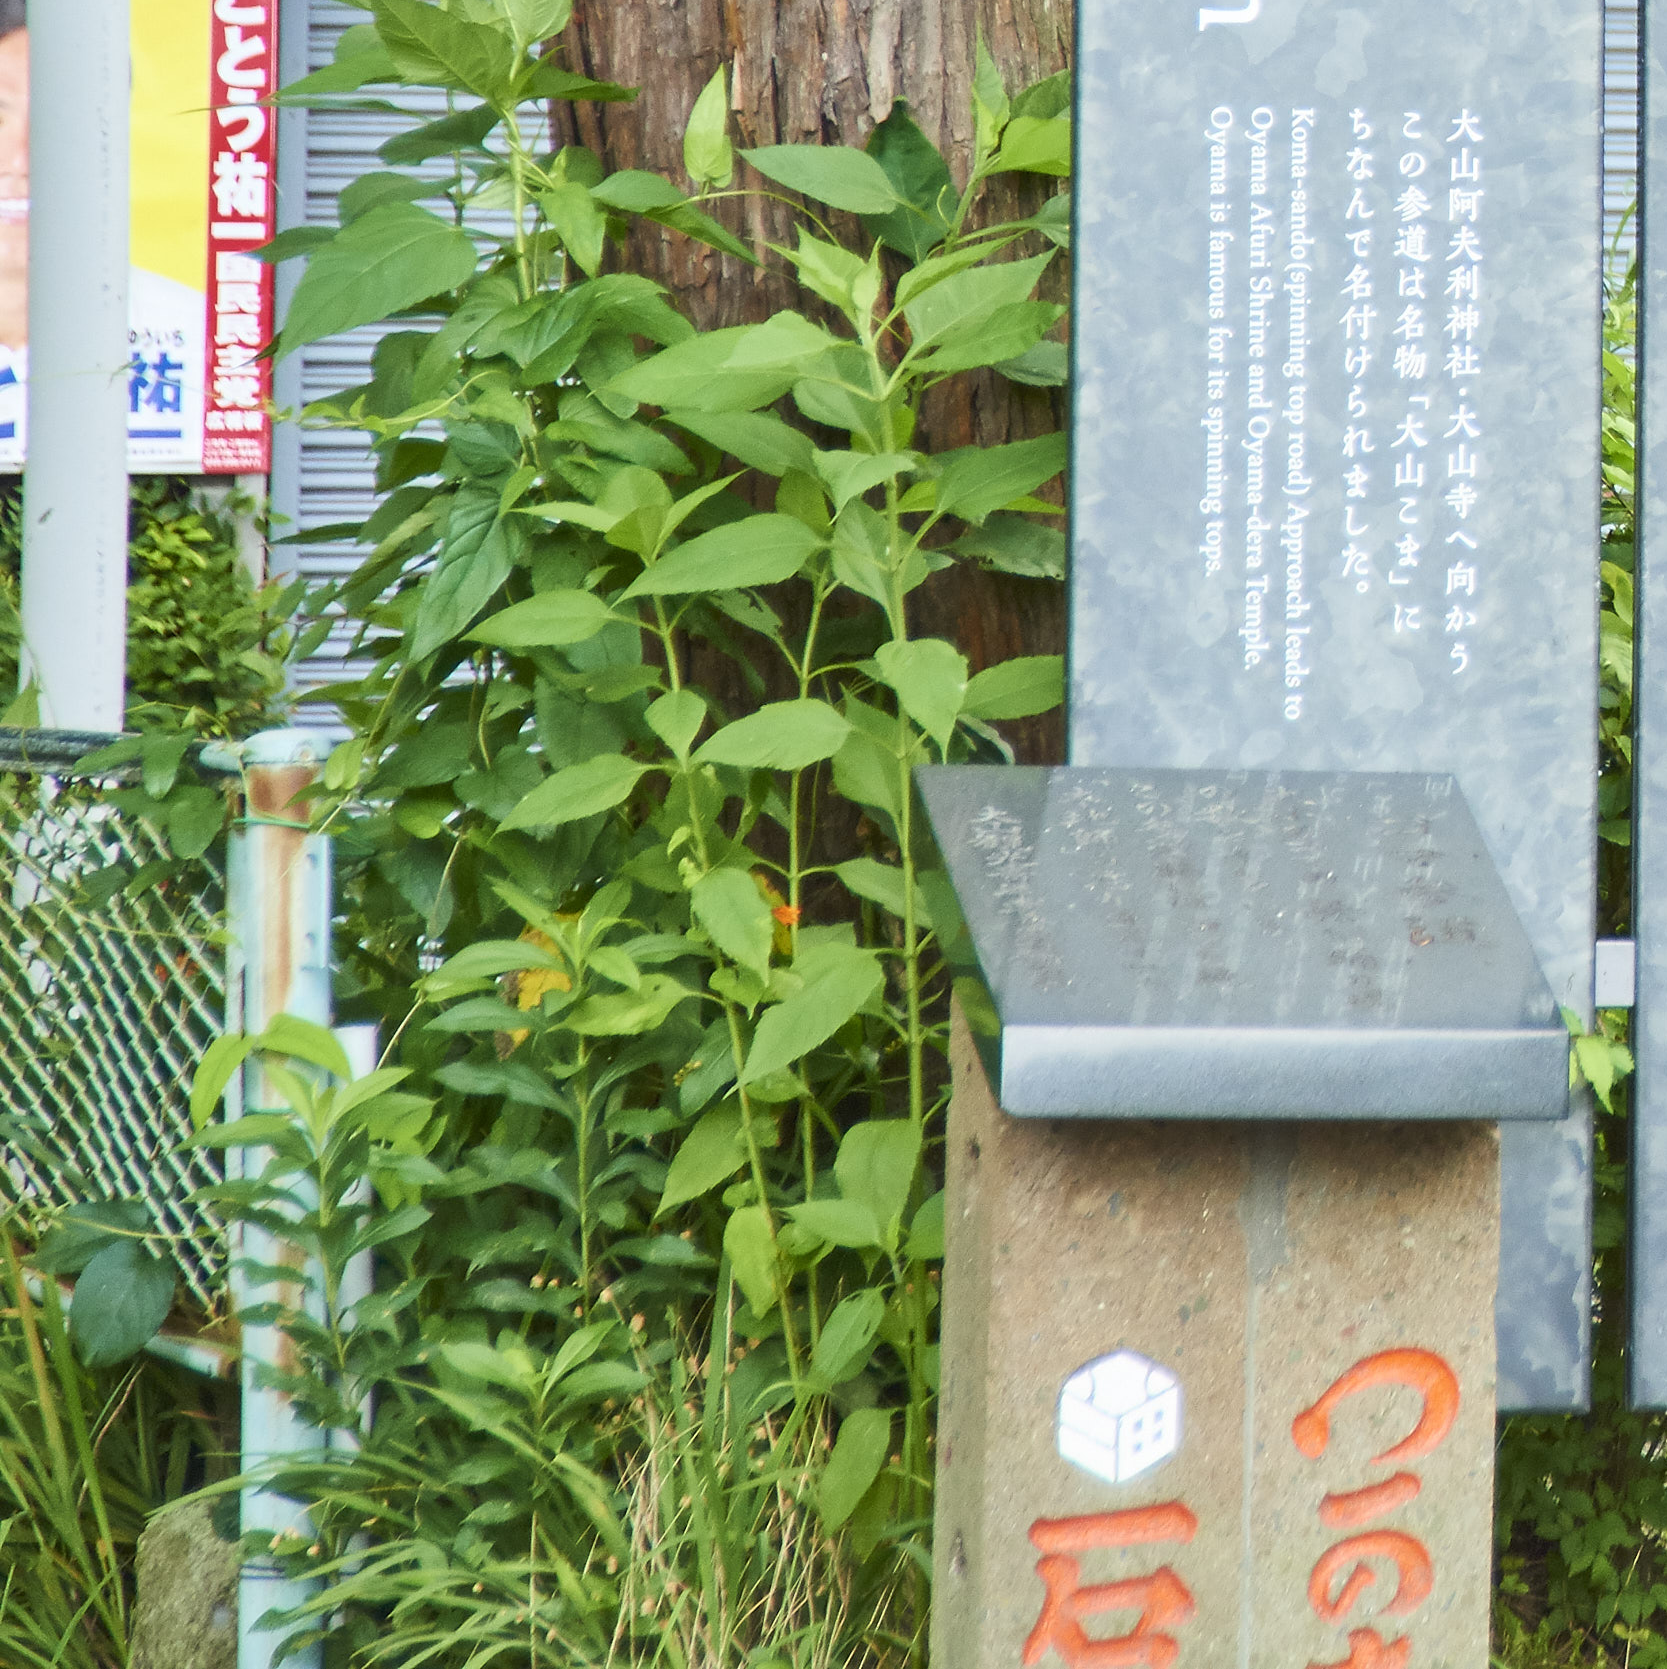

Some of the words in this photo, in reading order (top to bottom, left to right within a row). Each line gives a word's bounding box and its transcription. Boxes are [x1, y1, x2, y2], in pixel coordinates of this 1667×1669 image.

[1203, 106, 1233, 195] Oyama
[1244, 107, 1274, 196] Oyama
[1209, 201, 1232, 223] is
[1249, 201, 1275, 269] Afuri
[1207, 230, 1235, 320] famous
[1207, 327, 1233, 364] for
[1249, 276, 1275, 358] Shrine
[1339, 107, 1378, 594] ちなんで名付けられました。
[1207, 370, 1230, 401] its
[1247, 364, 1273, 409] and
[1282, 385, 1307, 425] top
[1388, 111, 1432, 633] この参道は名物「大山こま」に
[1443, 108, 1485, 675] 大山阿夫利神社・大山寺へ向かう
[1199, 406, 1230, 515] spinning
[1240, 416, 1272, 569] Oyama-dera
[1280, 432, 1313, 495] road)
[1199, 520, 1225, 578] tops.
[1280, 502, 1312, 619] Approach
[1238, 574, 1270, 671] Temple.
[1284, 626, 1311, 688] leads
[1284, 695, 1303, 721] to
